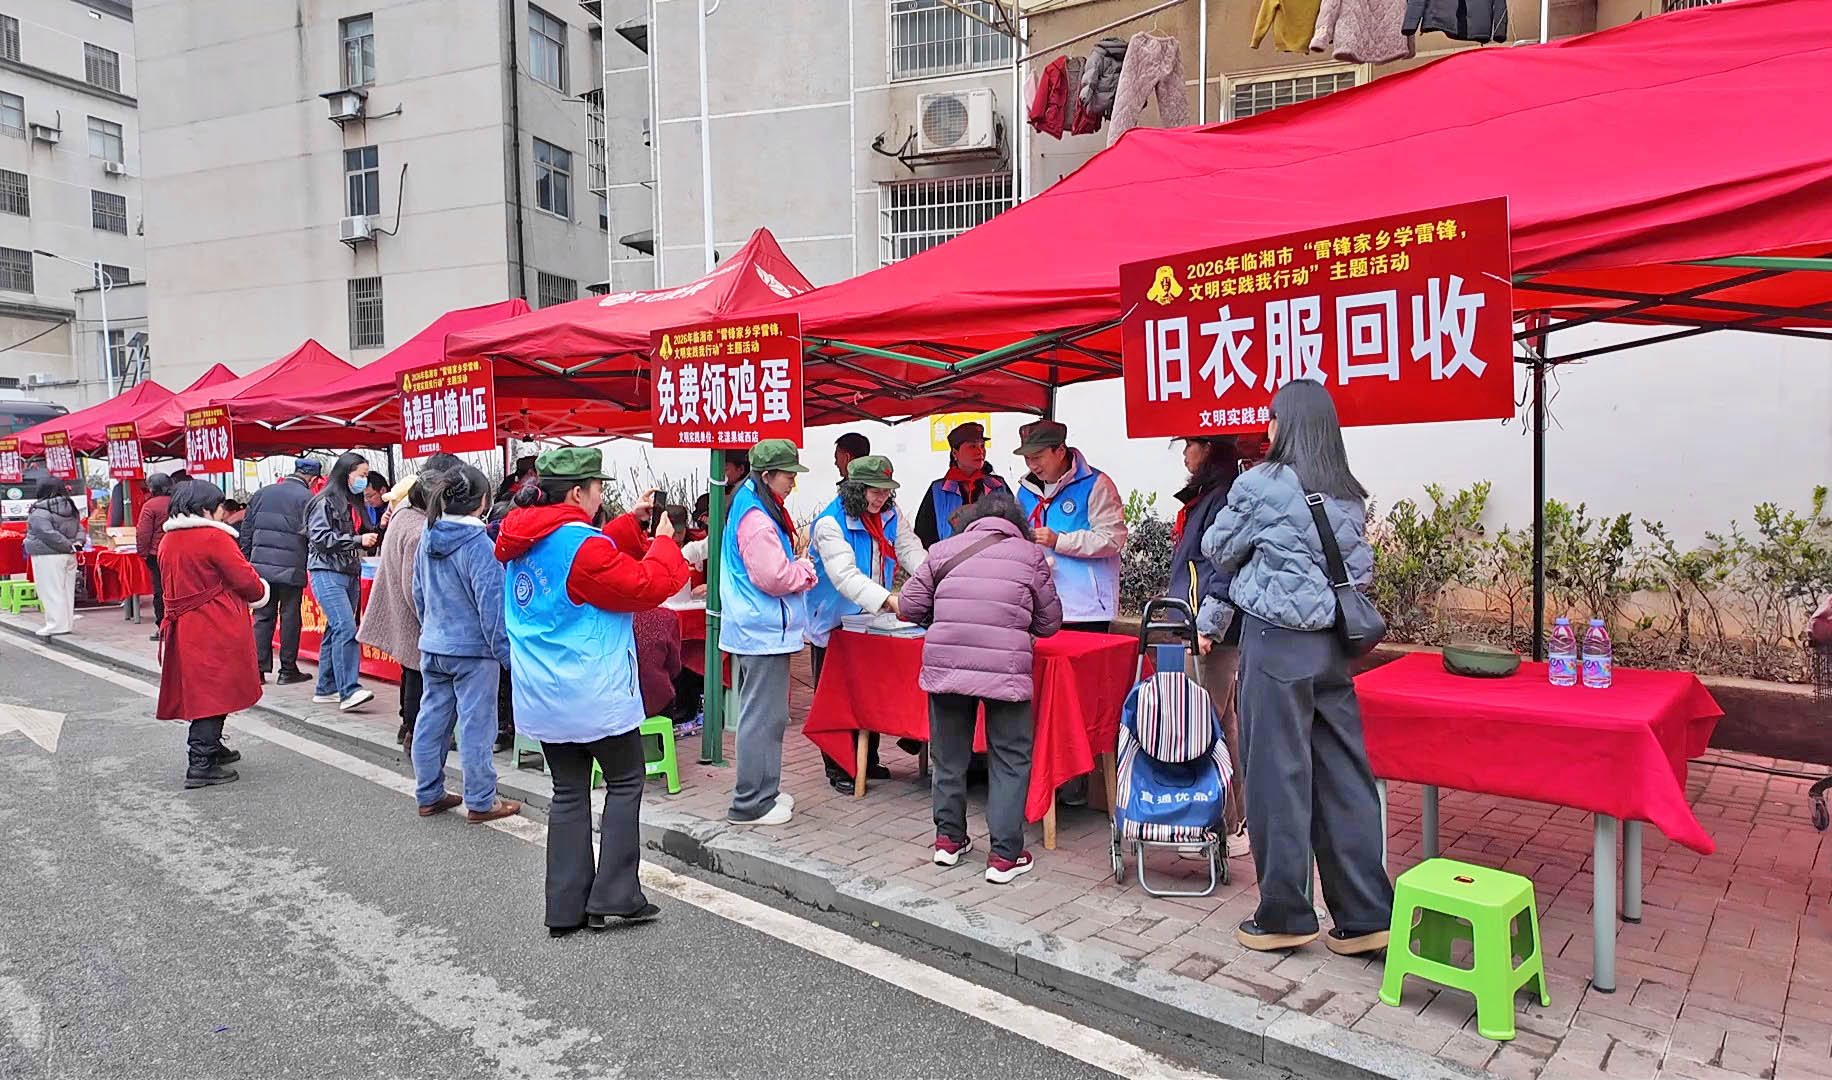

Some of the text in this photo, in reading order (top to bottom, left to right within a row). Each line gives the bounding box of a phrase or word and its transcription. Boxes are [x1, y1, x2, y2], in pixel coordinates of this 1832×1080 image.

[1144, 274, 1487, 402] 旧衣服回收
[403, 387, 488, 442] 免费量血糖血压
[657, 358, 791, 425] 免费领鸡蛋
[1199, 405, 1271, 428] 文明实践单
